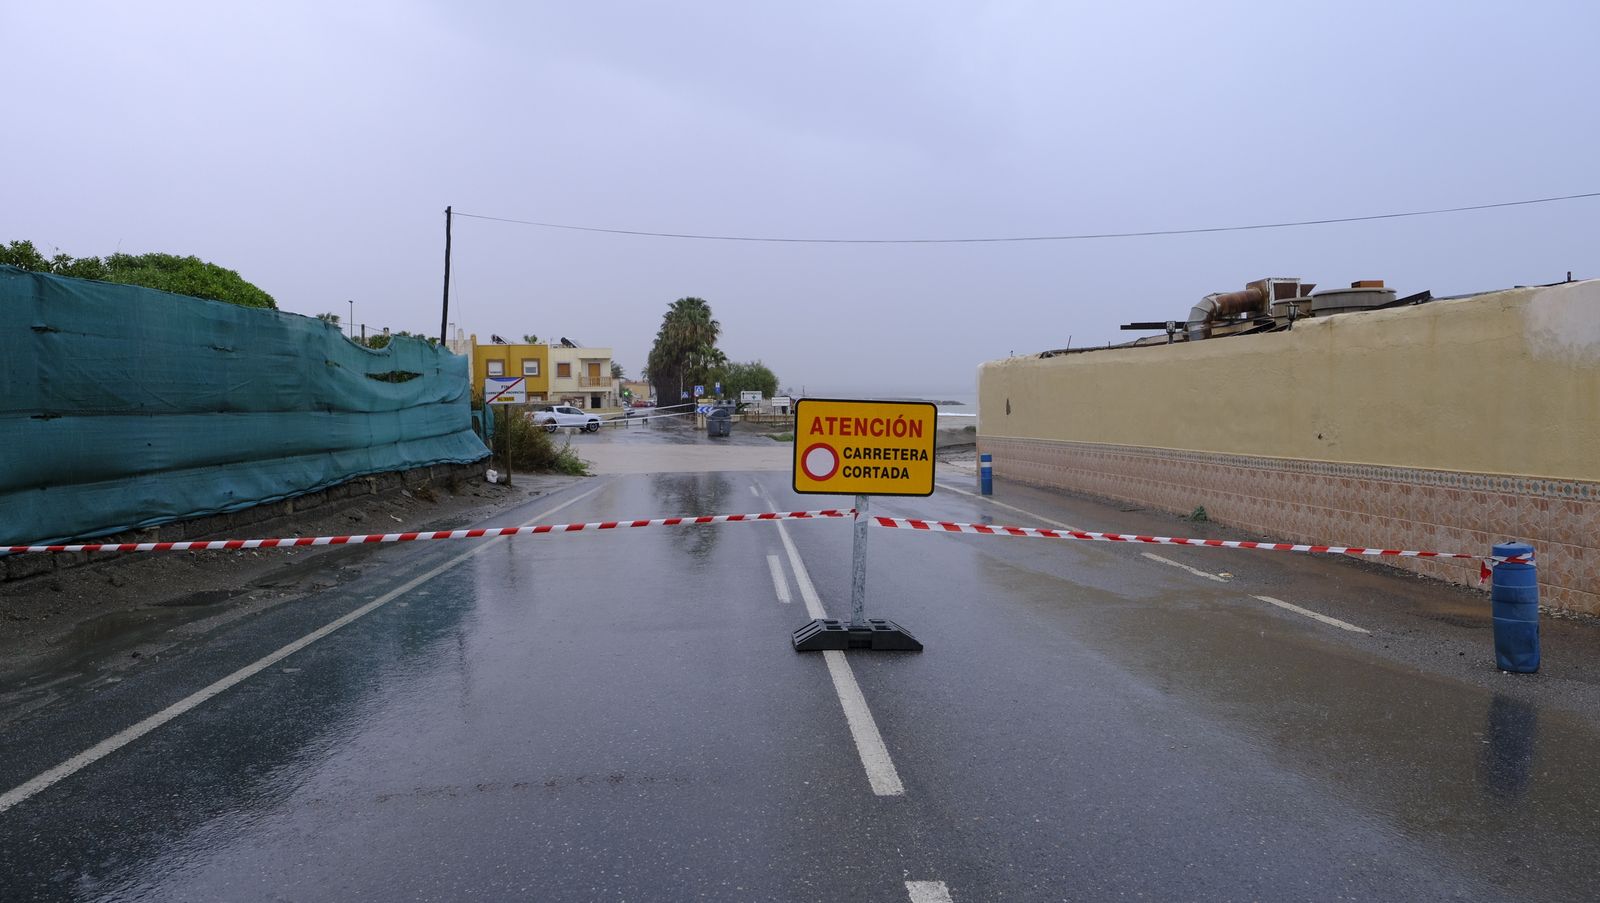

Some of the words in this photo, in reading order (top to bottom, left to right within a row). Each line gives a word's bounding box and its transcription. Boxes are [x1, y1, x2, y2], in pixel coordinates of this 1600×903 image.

[810, 414, 923, 438] ATENCIÓN
[843, 447, 928, 461] CARRETERA
[842, 466, 909, 479] CORTADA
